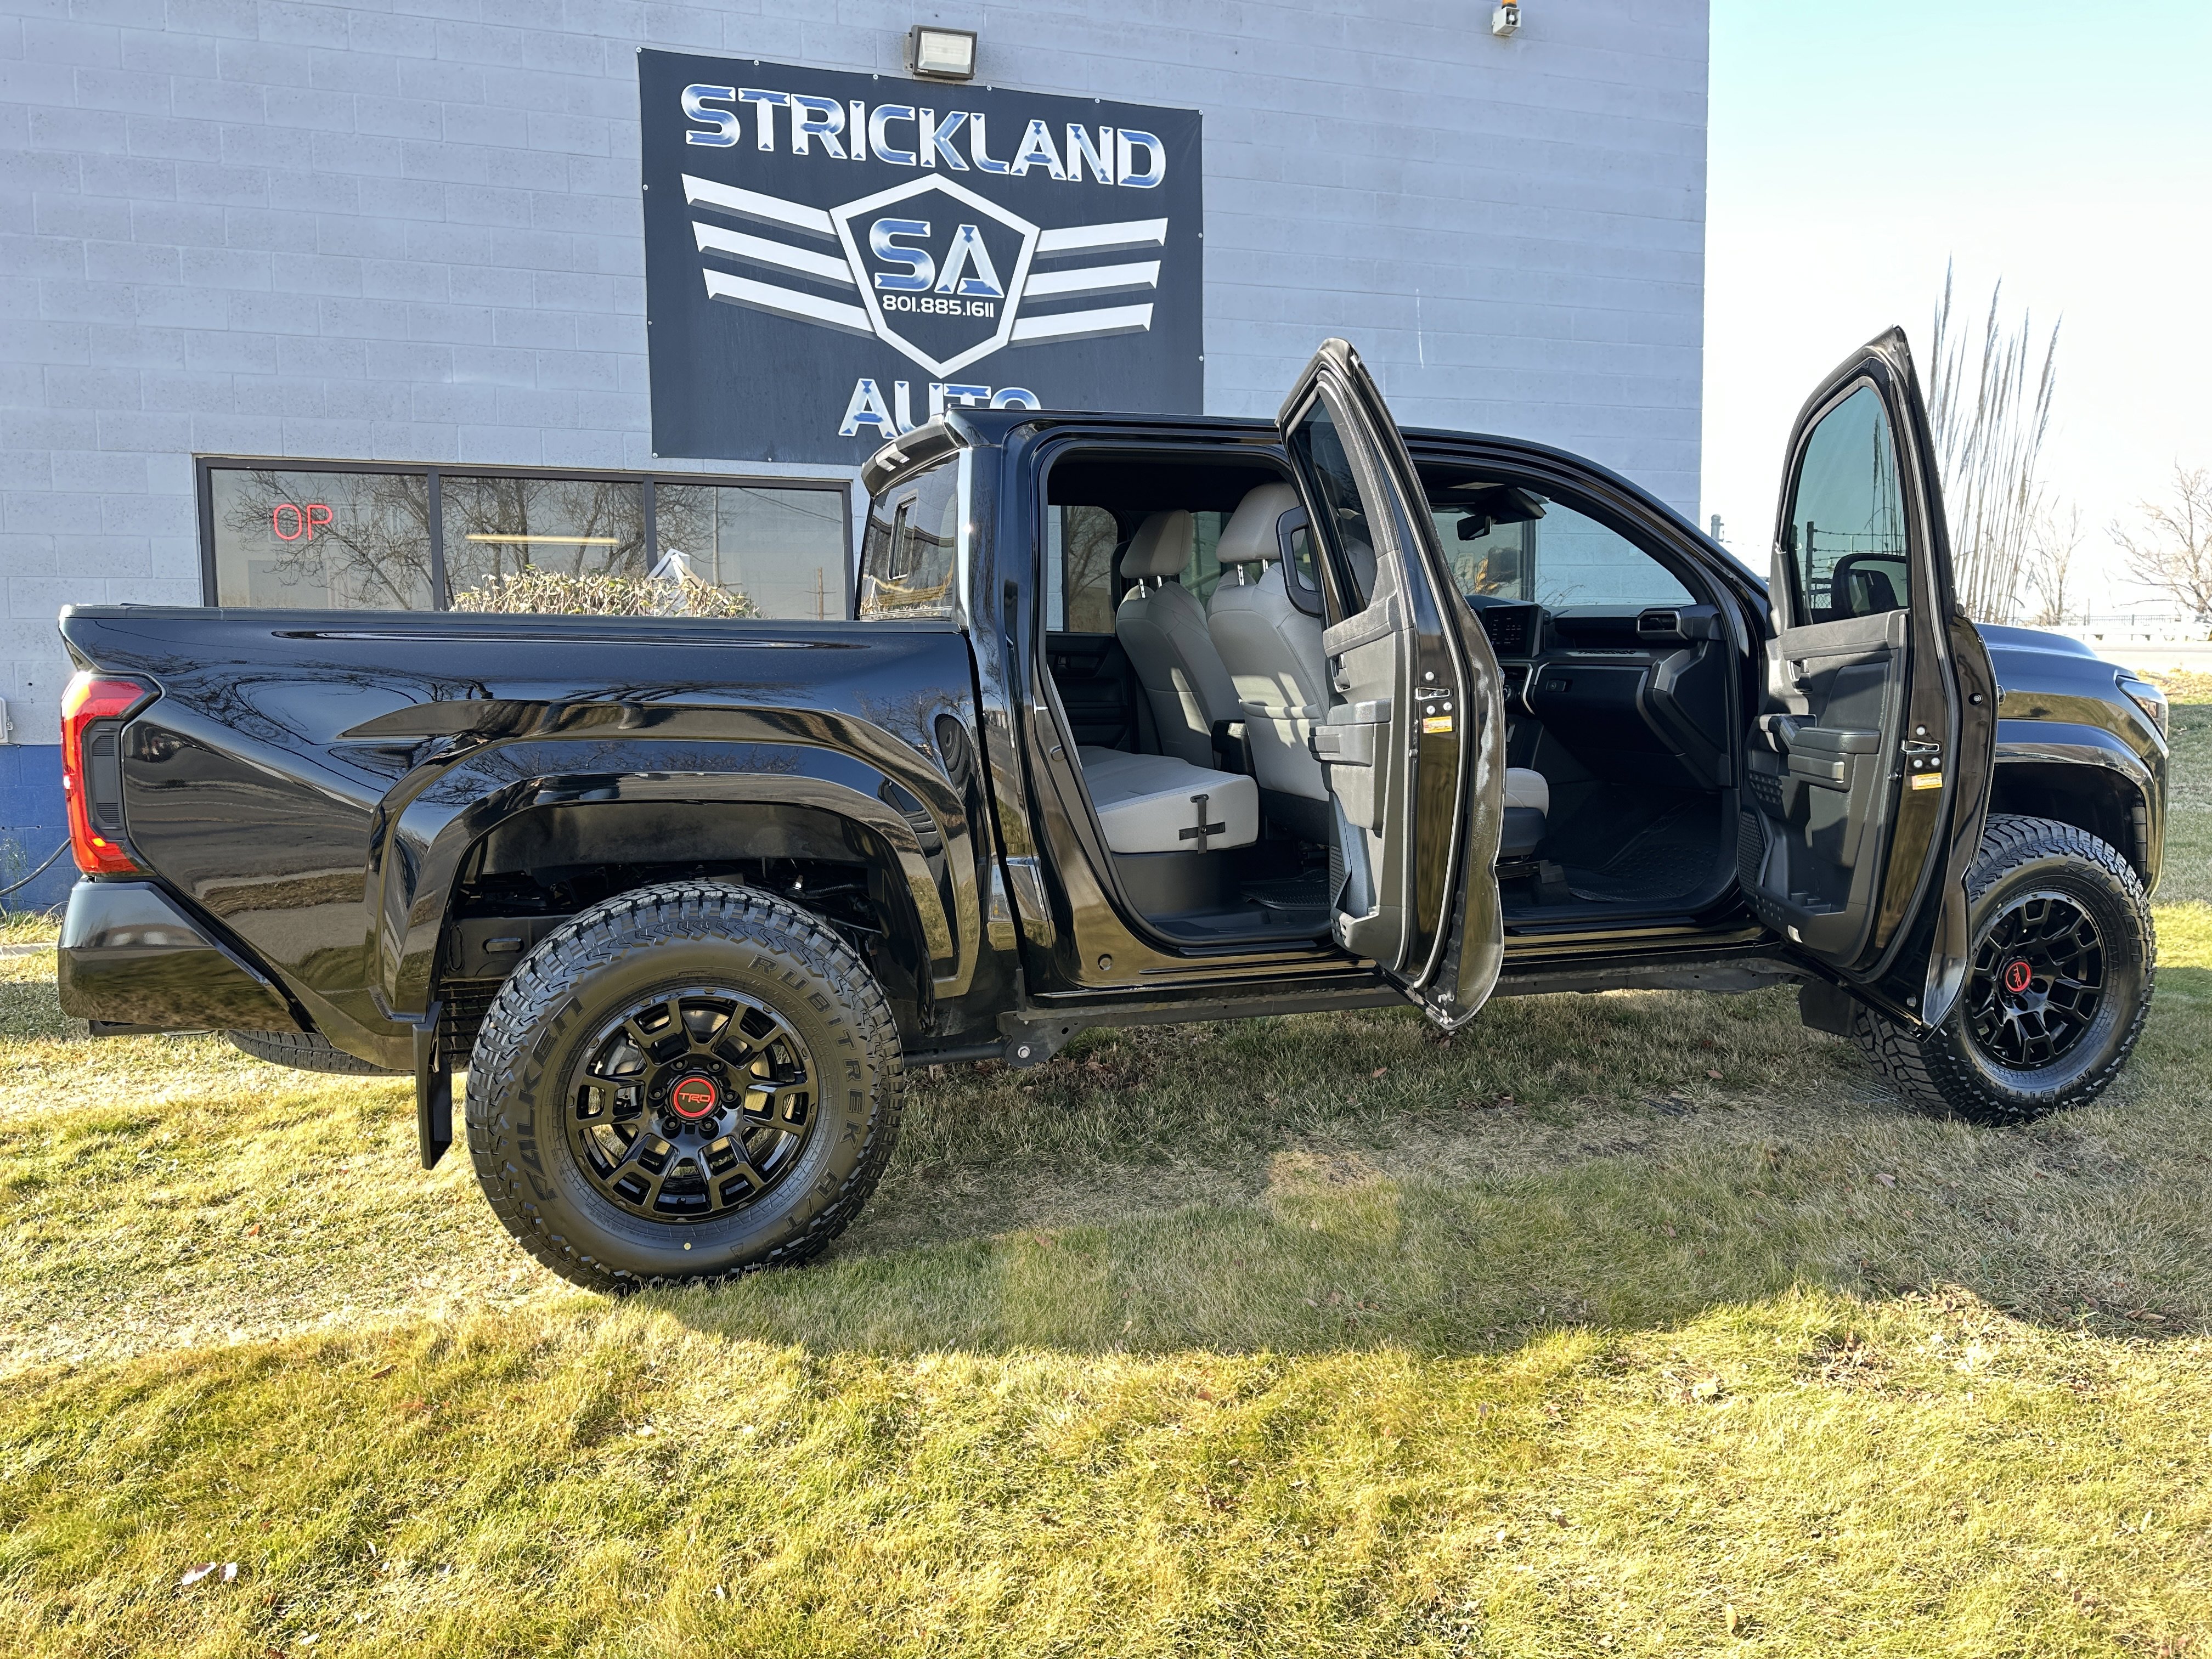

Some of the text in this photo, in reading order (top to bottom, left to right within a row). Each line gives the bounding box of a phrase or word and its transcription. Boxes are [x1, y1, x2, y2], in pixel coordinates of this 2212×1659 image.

[681, 83, 1166, 188] STRICKLAND
[869, 218, 1005, 298] SA
[883, 295, 994, 318] 801.885.1611
[2013, 965, 2022, 988] TRD
[747, 953, 865, 1149] RUBITREK
[516, 996, 585, 1208] FALKEN
[678, 1092, 712, 1104] TRD
